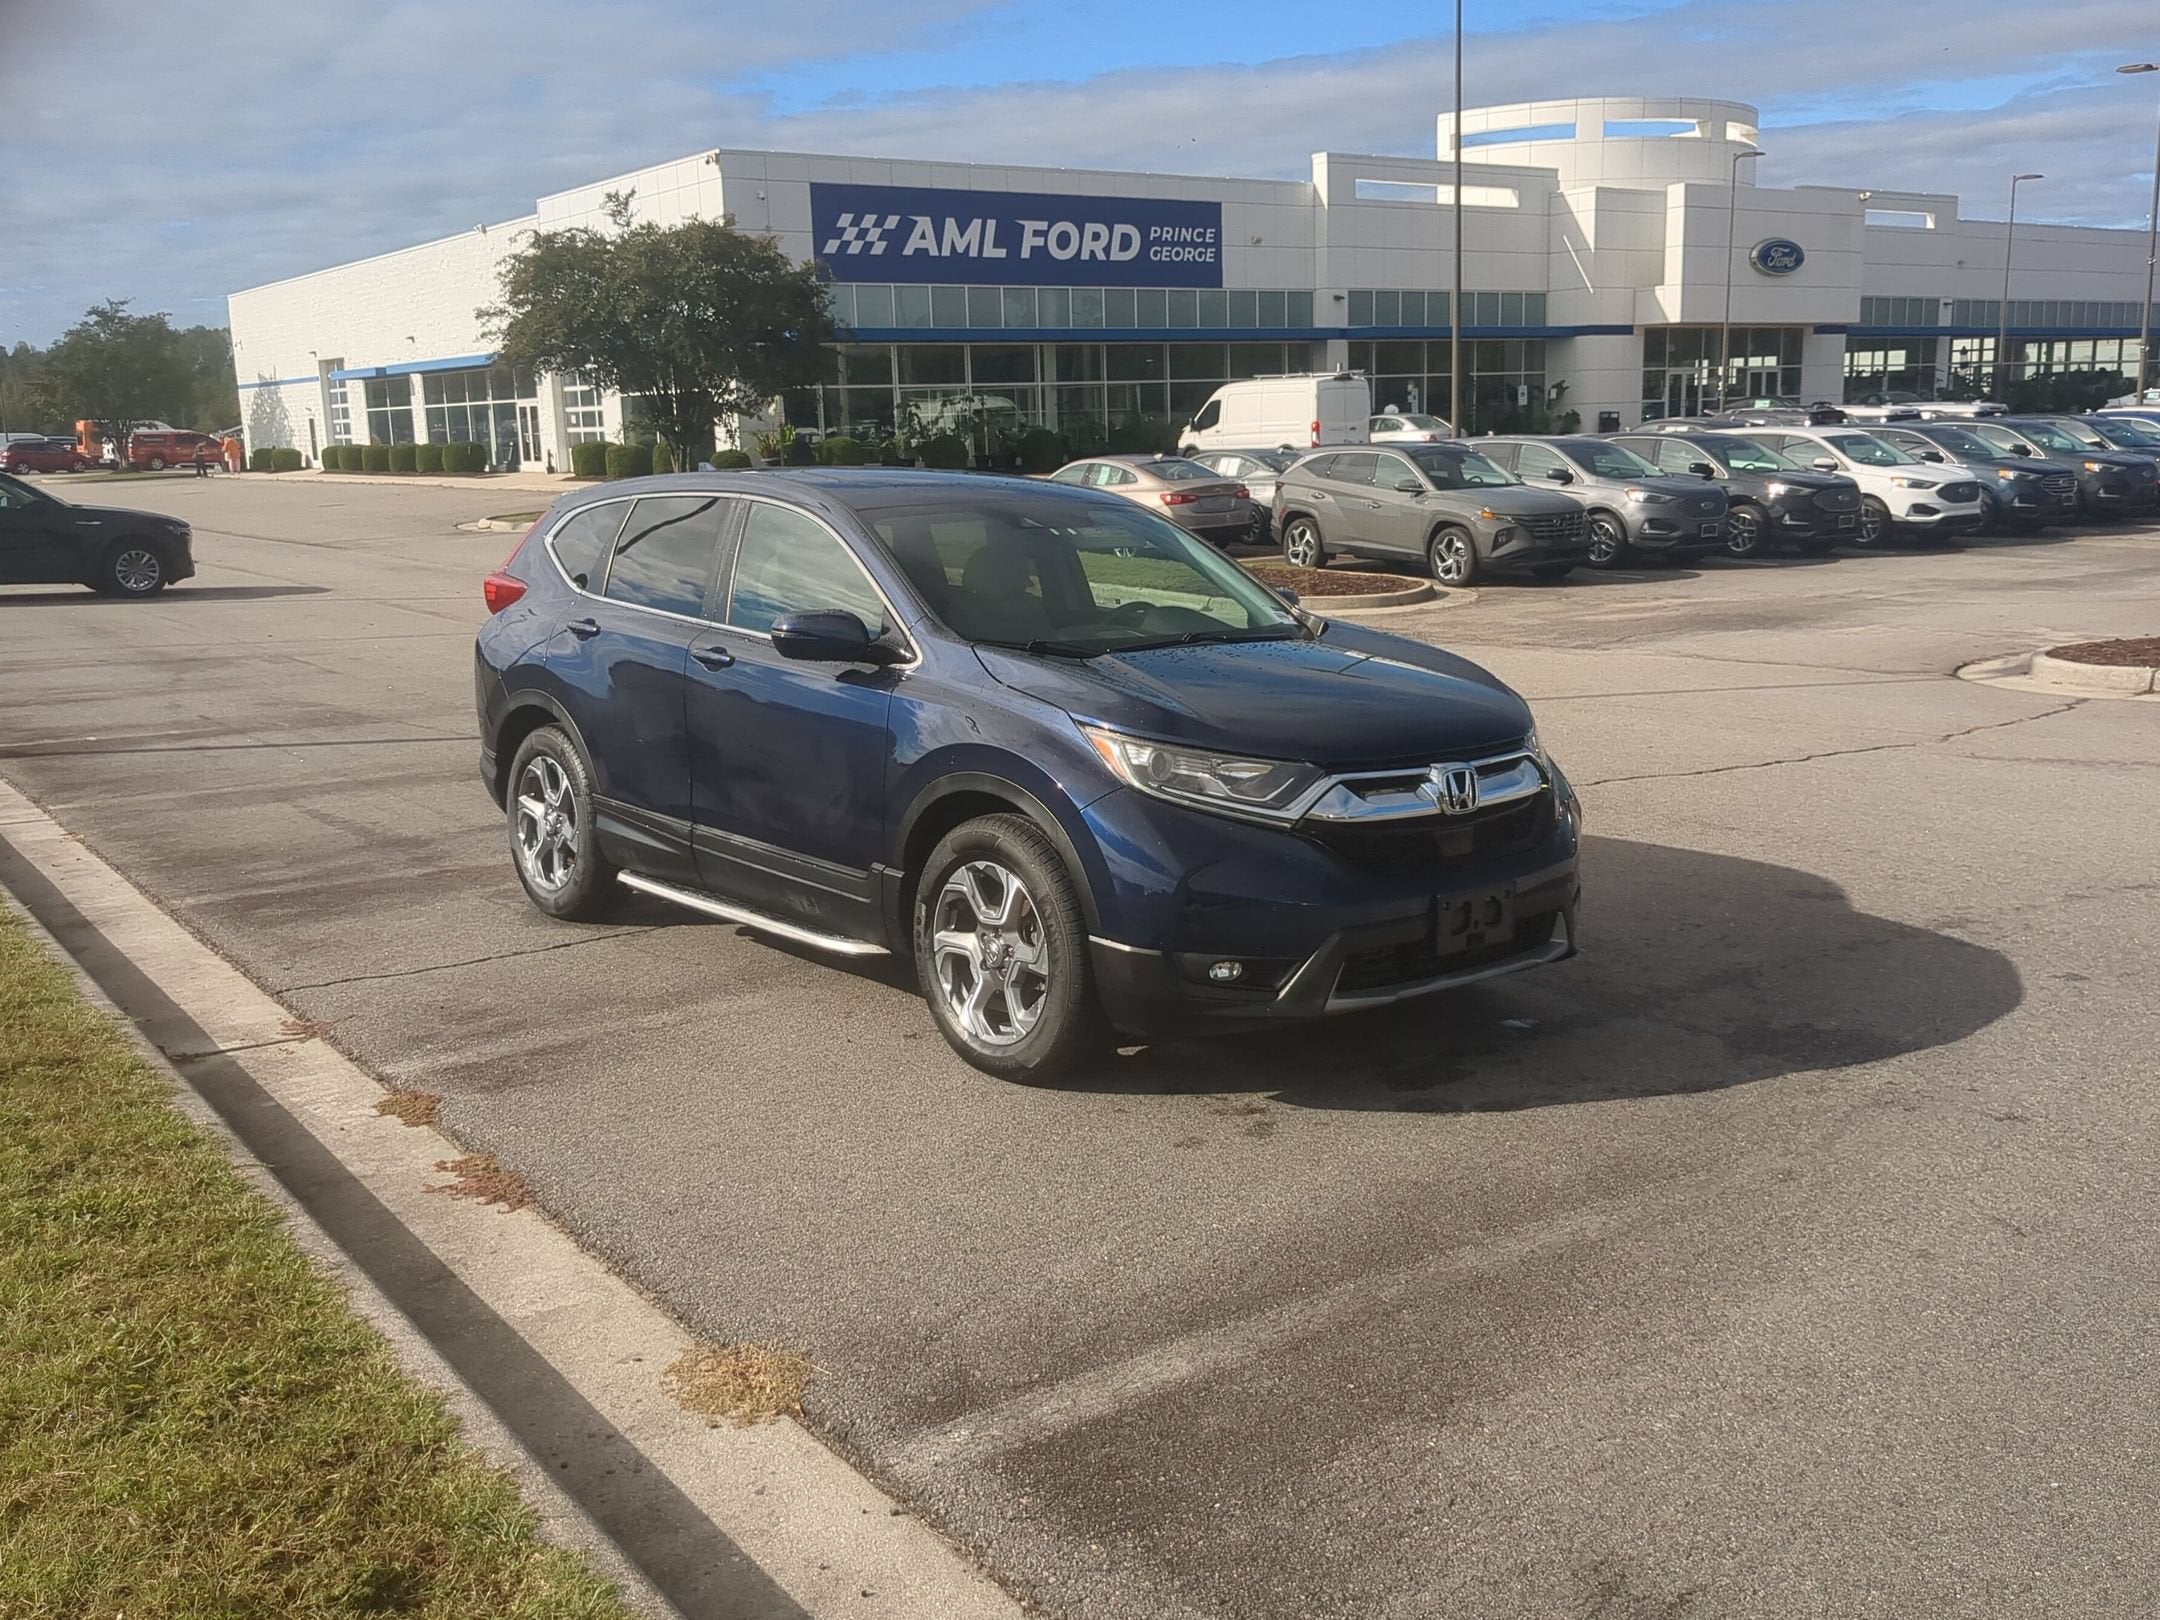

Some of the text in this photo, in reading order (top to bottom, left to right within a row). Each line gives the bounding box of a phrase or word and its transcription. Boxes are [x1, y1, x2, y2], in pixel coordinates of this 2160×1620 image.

[902, 215, 1141, 261] AML FORD
[1149, 226, 1216, 243] PRINCE
[1149, 246, 1216, 262] GEORGE
[1767, 246, 1797, 268] Ford
